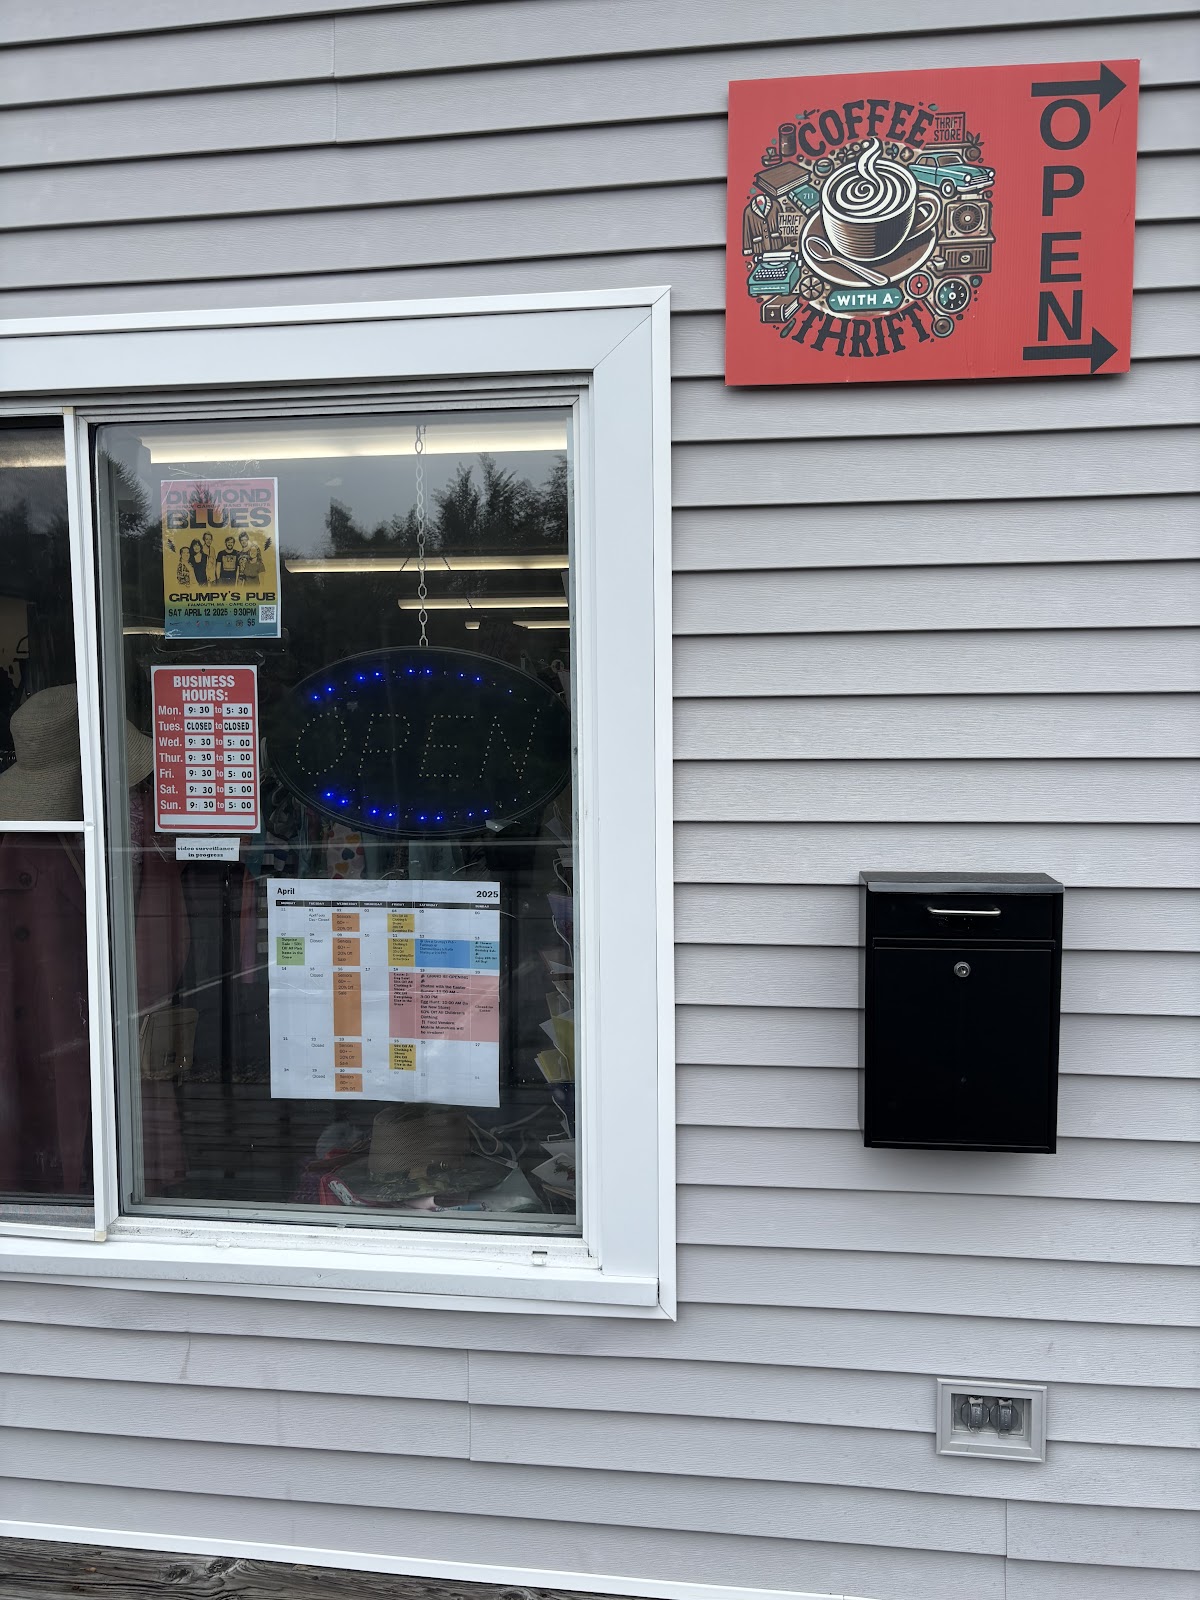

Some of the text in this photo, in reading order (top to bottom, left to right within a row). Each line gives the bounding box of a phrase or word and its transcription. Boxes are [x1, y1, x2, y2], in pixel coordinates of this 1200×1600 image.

[798, 98, 935, 157] COFFEE
[934, 116, 963, 129] THRIFT
[933, 129, 961, 141] STORE
[778, 214, 803, 226] THRIFT
[1037, 98, 1092, 342] OPEN
[778, 225, 799, 236] STORE
[791, 300, 931, 358] THRIFT
[166, 488, 272, 505] DIAMOND
[166, 506, 272, 529] BLUES
[168, 591, 276, 602] GRUMPY'S PUB
[168, 608, 182, 617] SAT
[184, 608, 202, 616] APRIL
[204, 608, 211, 616] 12
[212, 608, 228, 616] 2025
[247, 618, 256, 627] $5
[173, 675, 235, 688] BUSINESS
[182, 689, 228, 701] HOURS:
[158, 706, 182, 715] Mon.
[158, 722, 183, 731] Tues.
[224, 722, 250, 730] CLOSED
[159, 737, 182, 746] Wed.
[295, 708, 541, 780] OPEN
[159, 753, 183, 762] Thur.
[160, 769, 174, 778] Fri.
[160, 785, 178, 794] Sat.
[160, 800, 181, 810] Sun.
[276, 887, 295, 896] April
